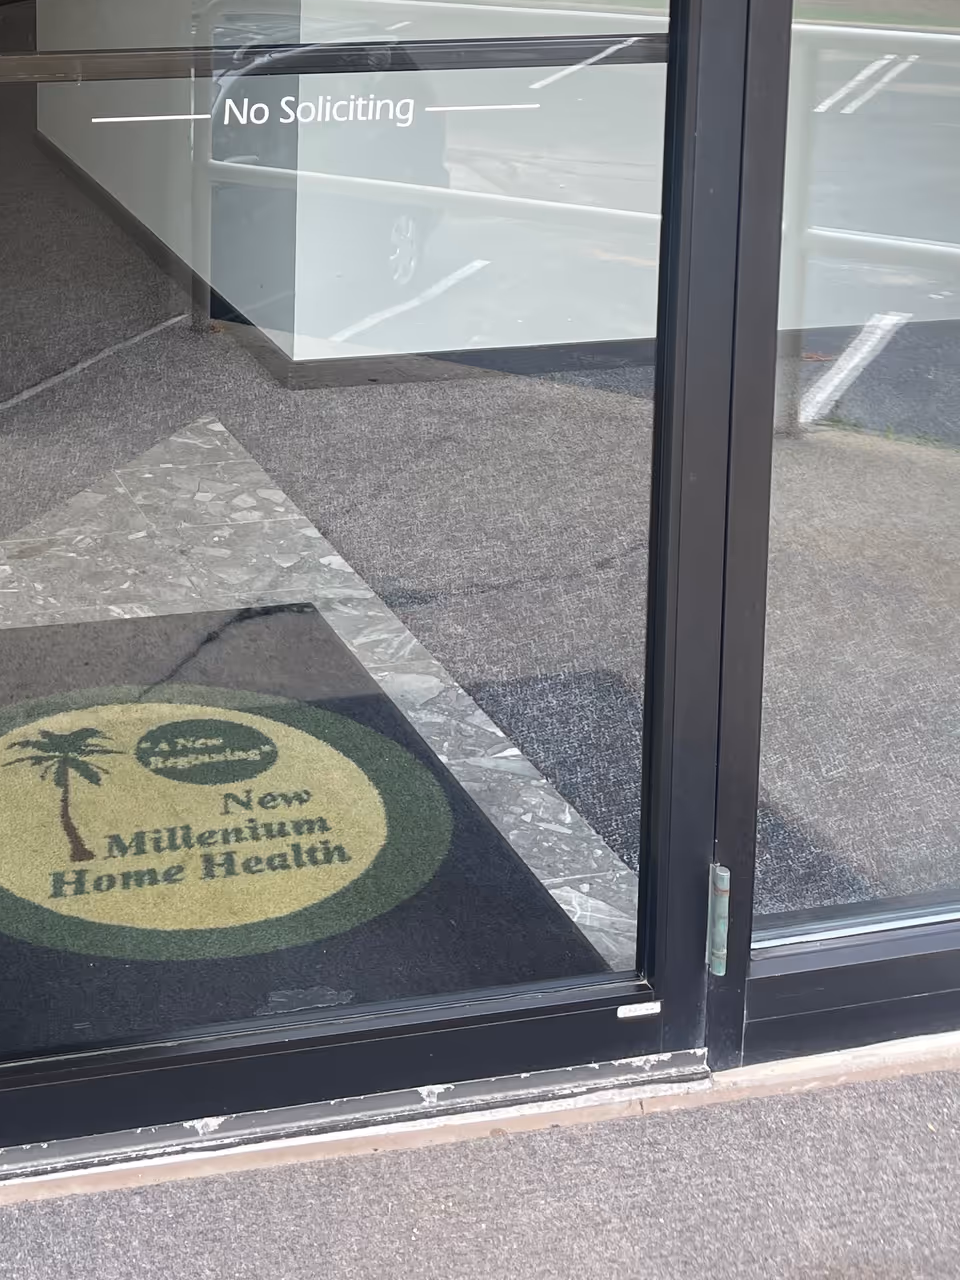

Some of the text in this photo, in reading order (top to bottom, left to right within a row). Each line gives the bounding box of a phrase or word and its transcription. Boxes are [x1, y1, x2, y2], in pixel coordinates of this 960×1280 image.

[222, 95, 415, 128] No Soliciting
[220, 789, 312, 815] New
[104, 816, 332, 861] Millenium
[48, 839, 352, 899] Home Health
